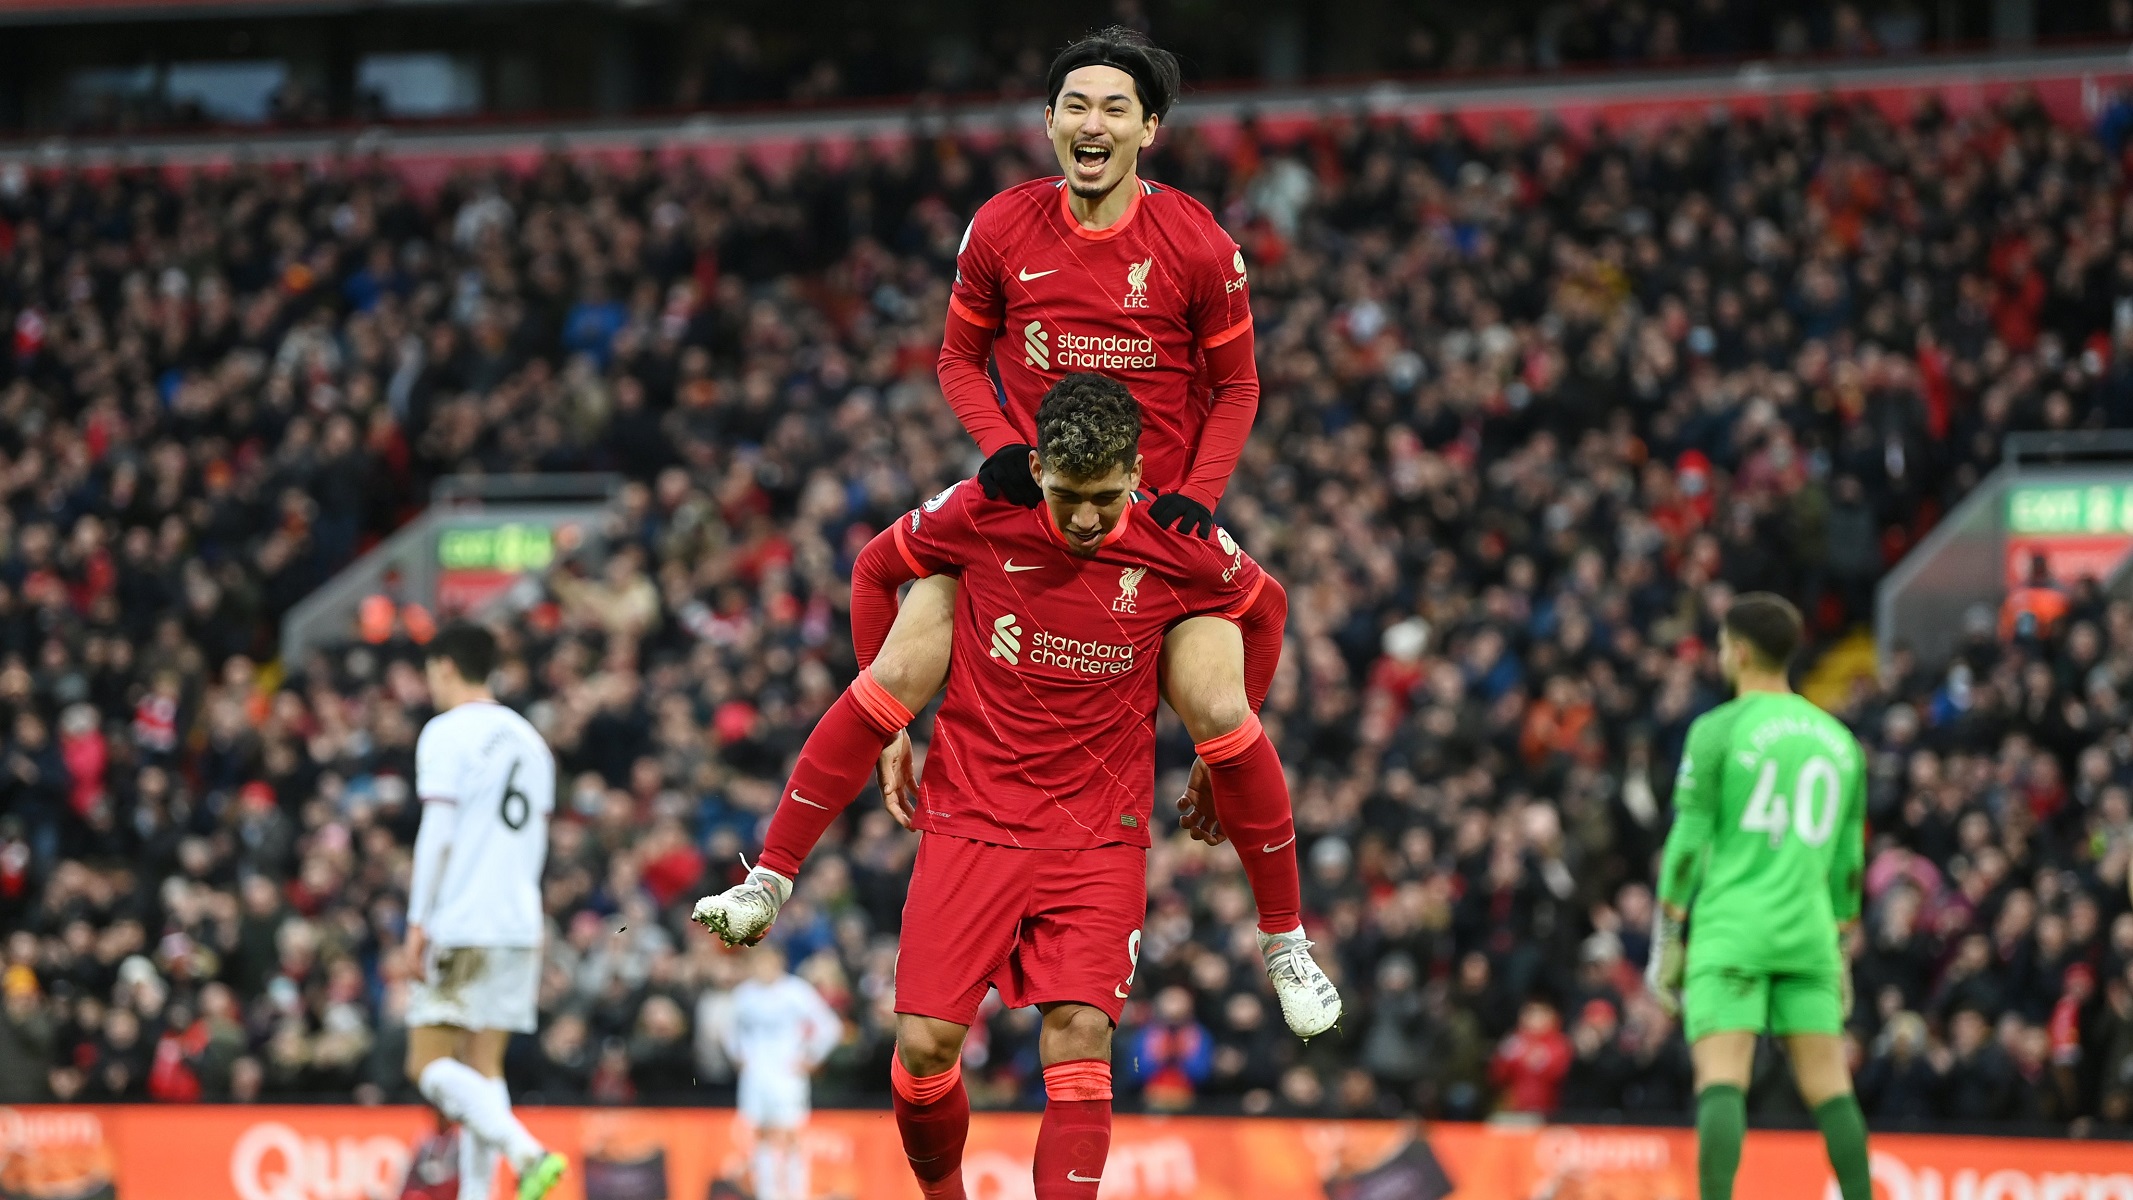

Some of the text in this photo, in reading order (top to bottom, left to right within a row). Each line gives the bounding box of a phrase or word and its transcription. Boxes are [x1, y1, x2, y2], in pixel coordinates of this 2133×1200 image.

[1058, 332, 1152, 353] standard
[1057, 351, 1156, 369] chartered
[1032, 631, 1133, 659] standard
[1030, 648, 1133, 674] chartered
[501, 757, 529, 830] 6
[1740, 755, 1841, 849] 40
